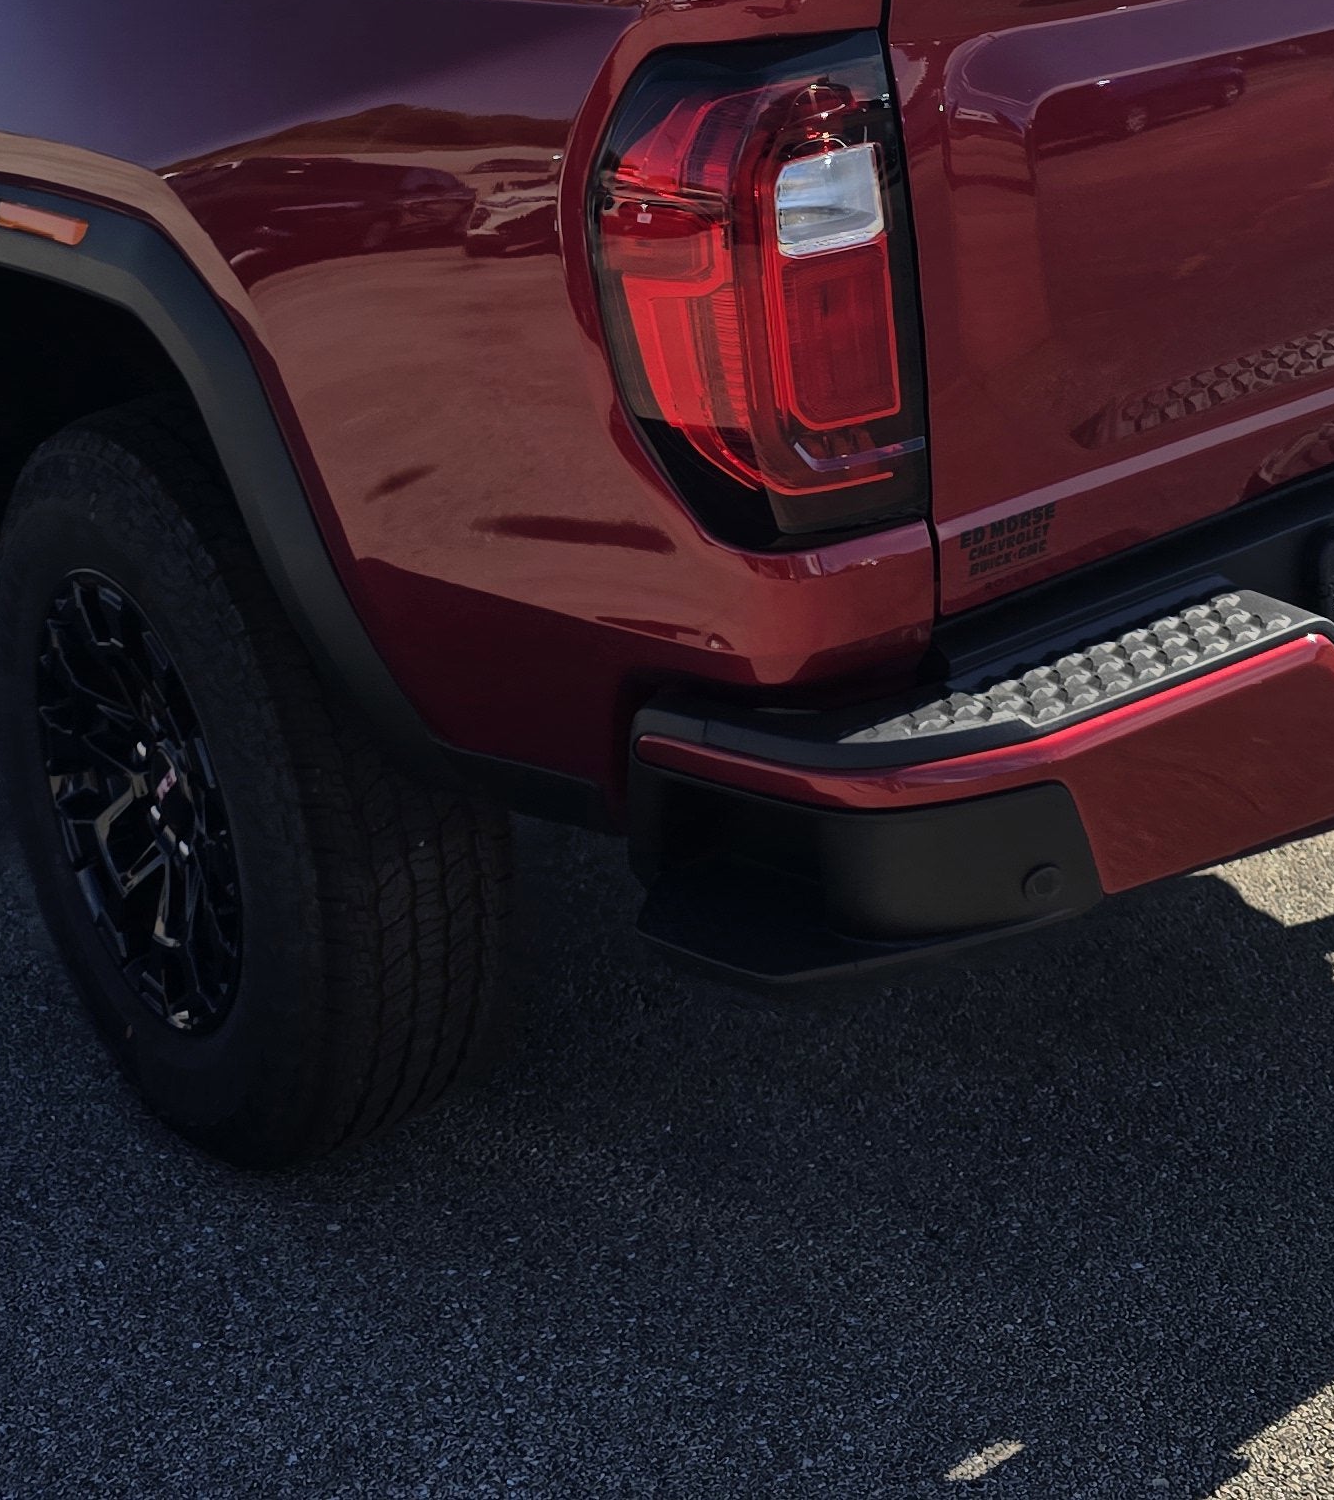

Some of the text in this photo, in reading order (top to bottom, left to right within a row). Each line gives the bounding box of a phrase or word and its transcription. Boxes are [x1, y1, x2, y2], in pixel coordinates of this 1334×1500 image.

[959, 501, 1056, 550] ED MORSE
[969, 522, 1050, 561] CHEVROLET
